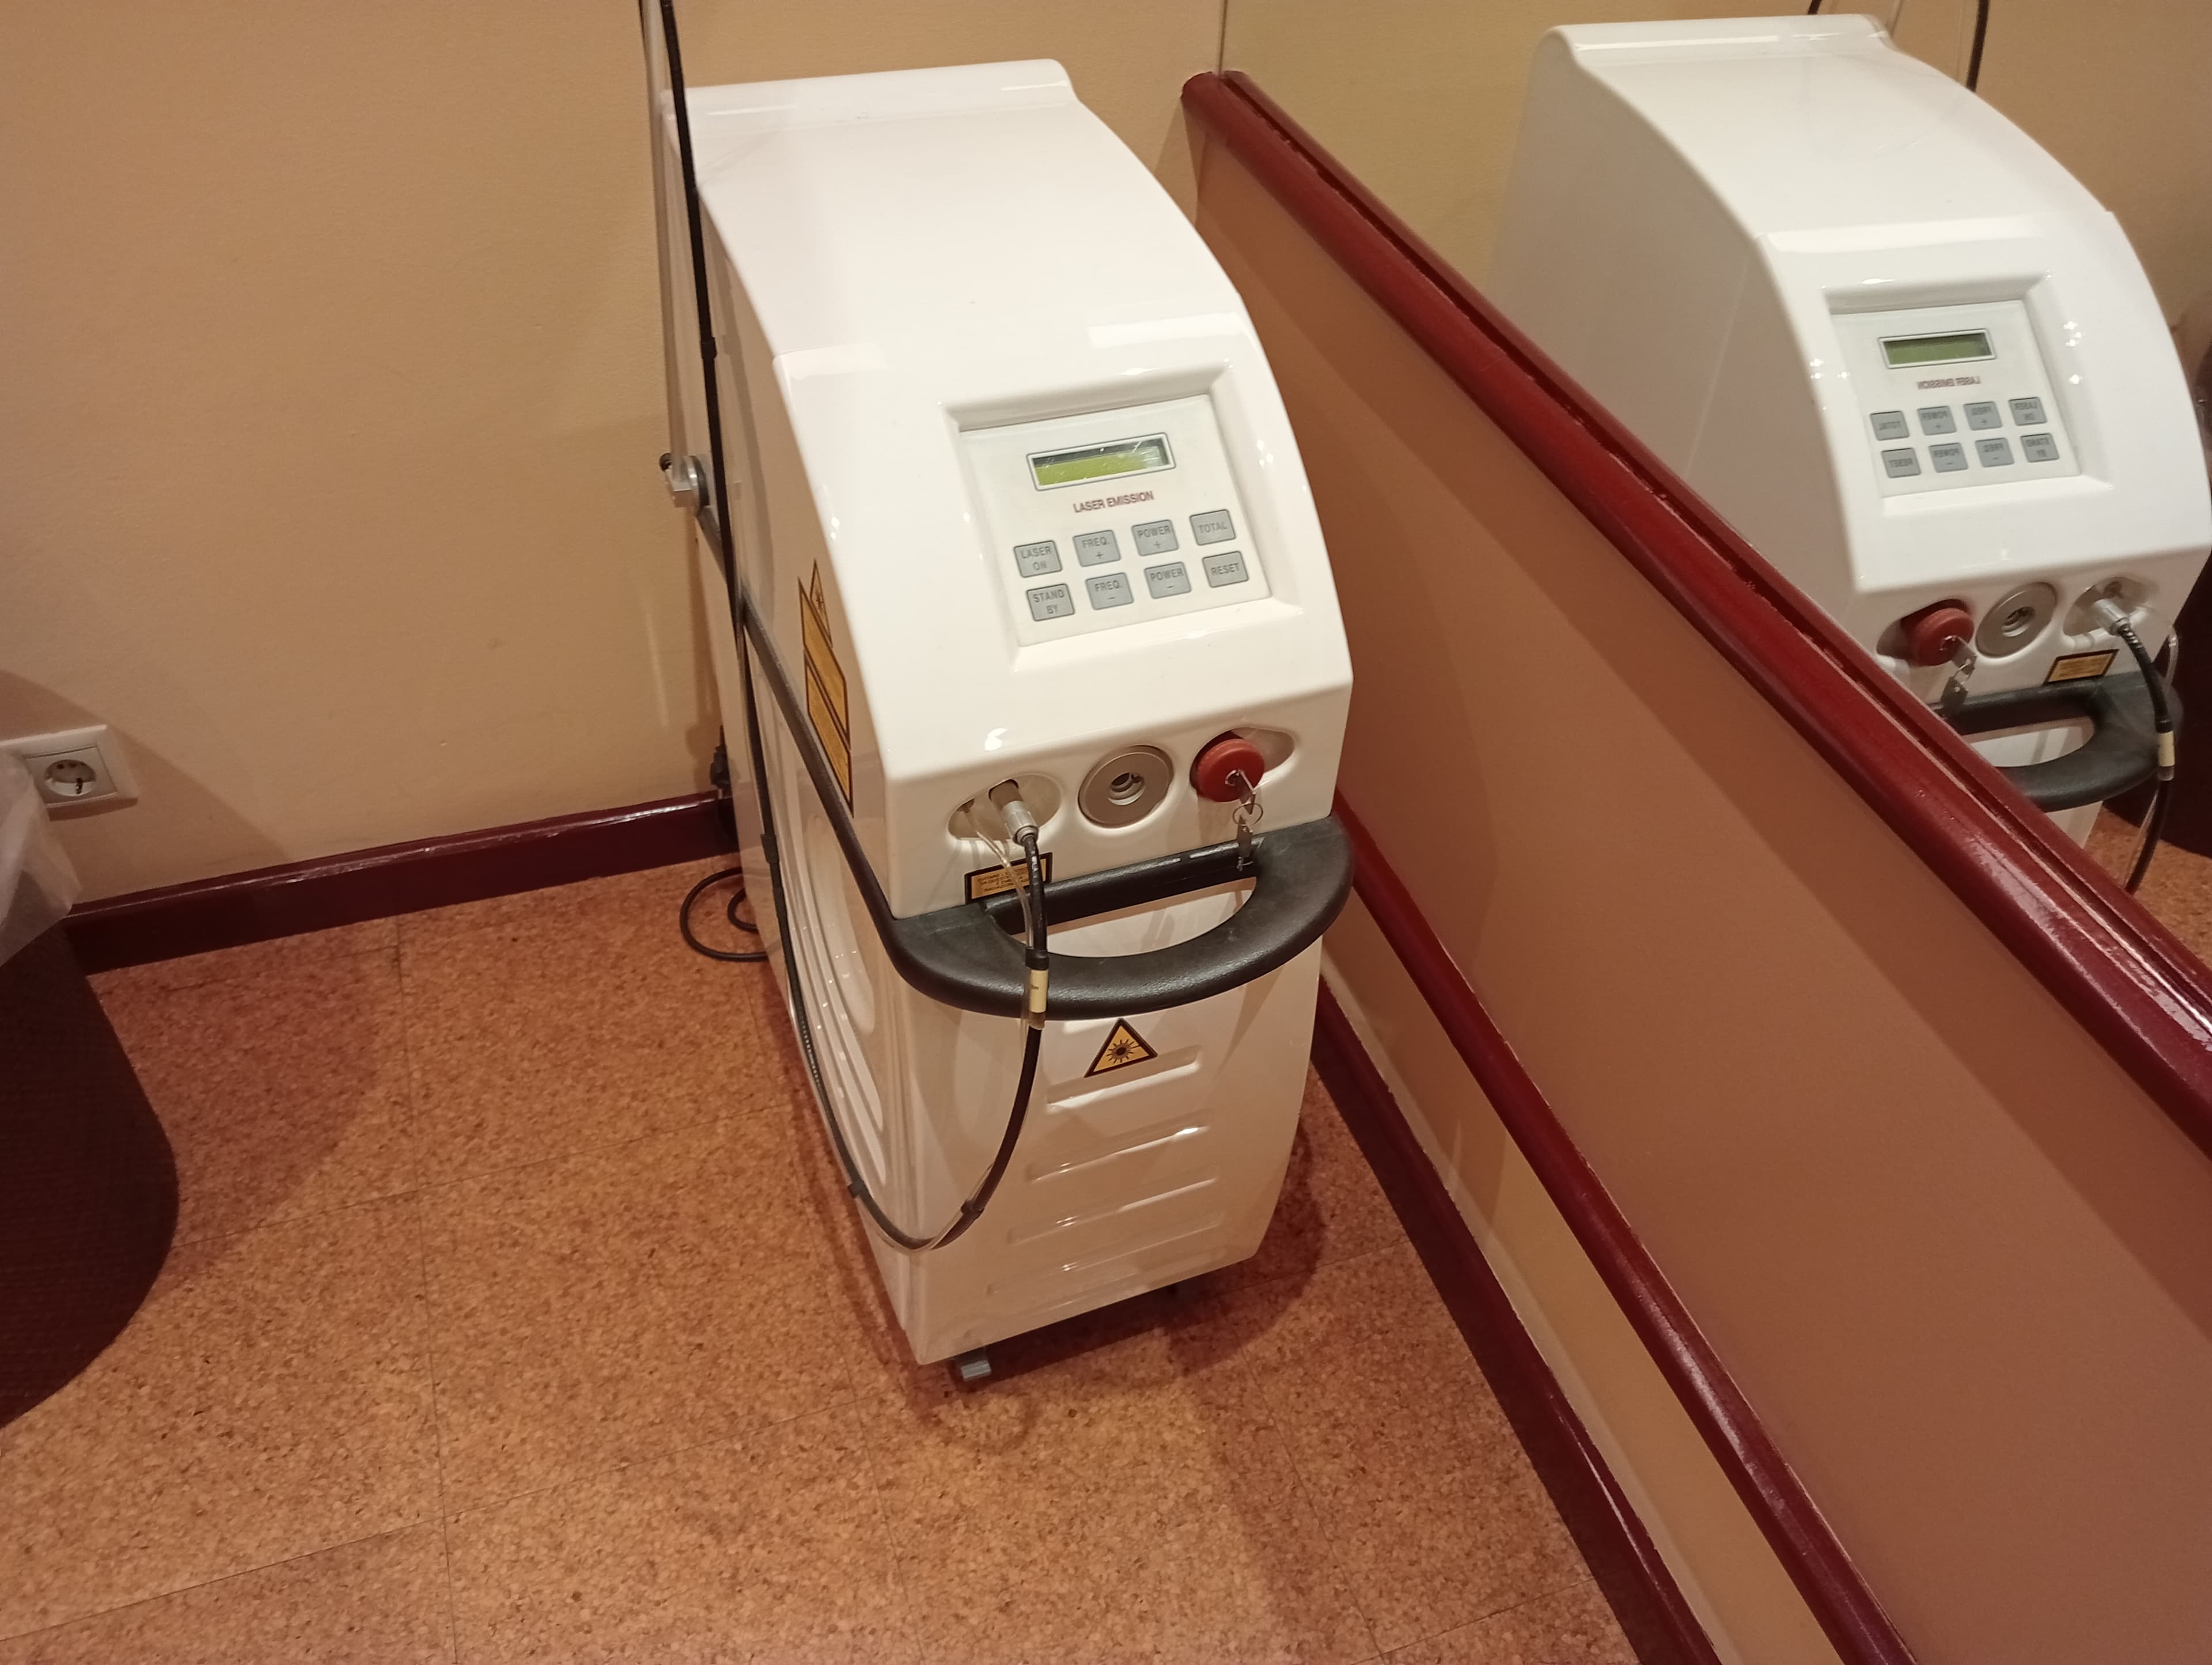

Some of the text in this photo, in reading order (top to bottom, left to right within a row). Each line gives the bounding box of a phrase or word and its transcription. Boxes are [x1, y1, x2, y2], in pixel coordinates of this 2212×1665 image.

[1073, 491, 1154, 513] LASER EMISSION
[1137, 525, 1171, 538] POWER
[1198, 522, 1228, 533] TOTAL
[1020, 546, 1052, 559] LASER
[1032, 561, 1048, 571] ON
[1211, 563, 1239, 576] RESET
[1150, 568, 1184, 581] POWER
[1033, 589, 1065, 602] STAND
[1047, 604, 1059, 614] BY
